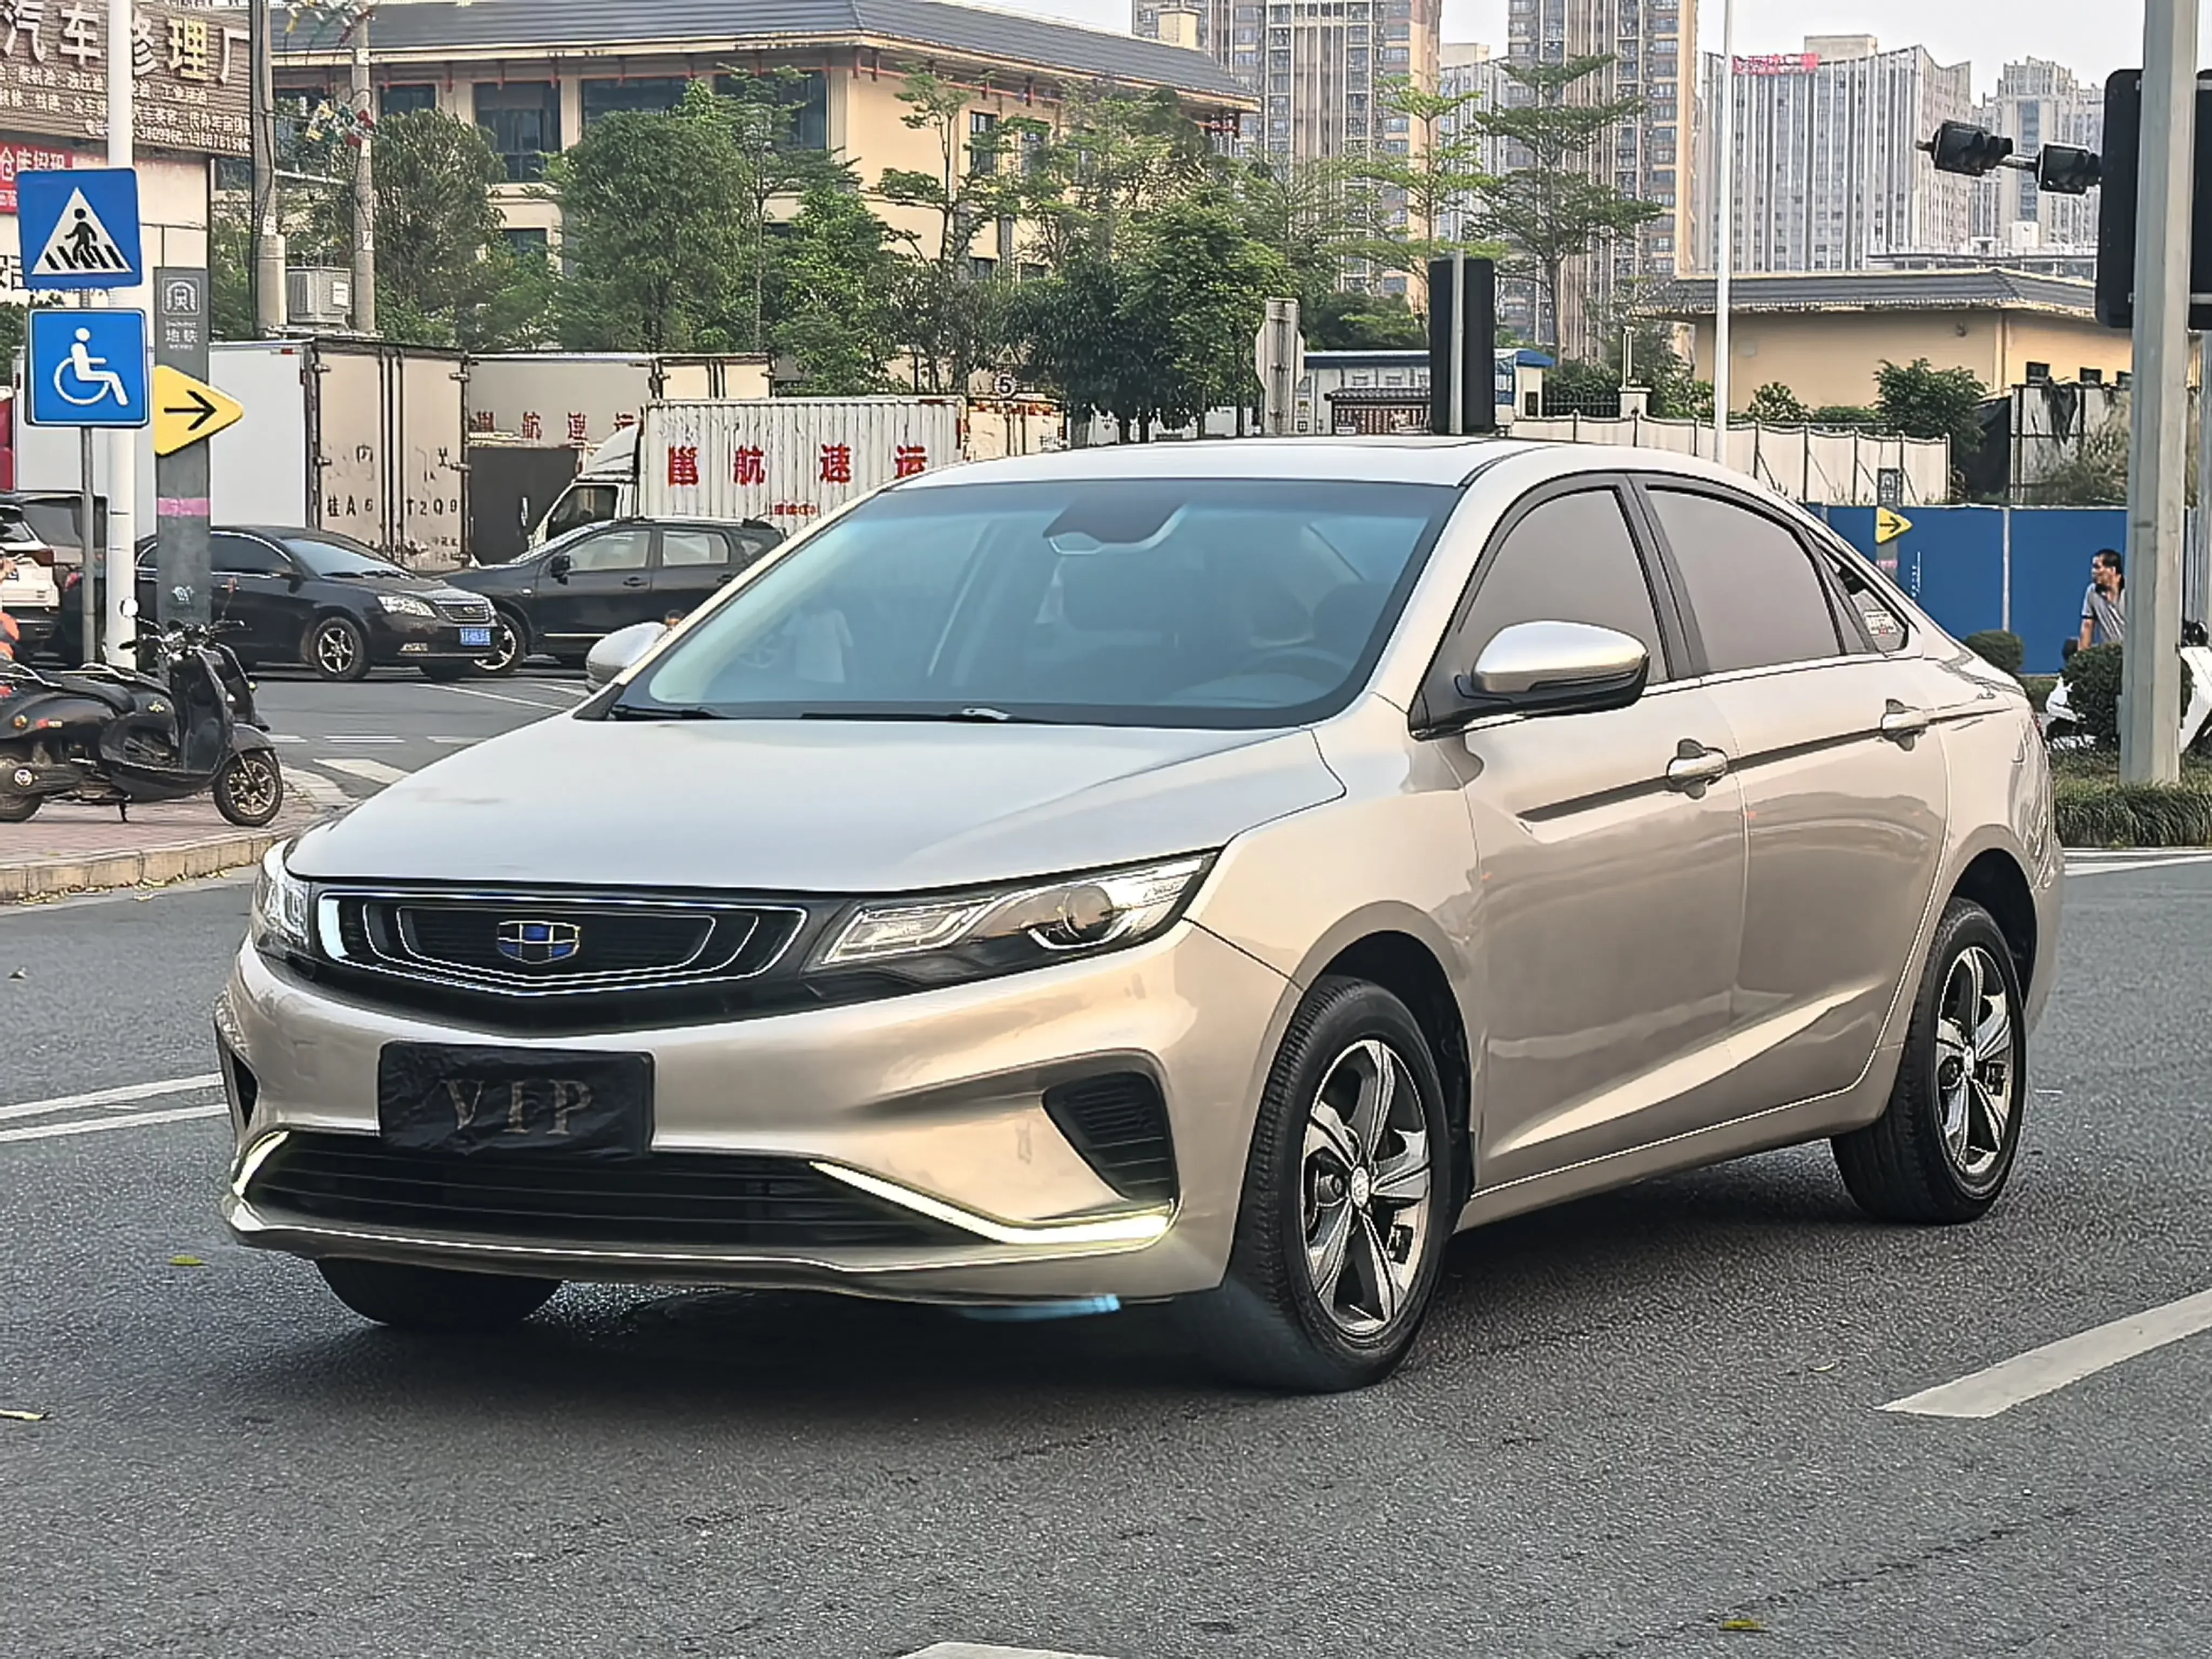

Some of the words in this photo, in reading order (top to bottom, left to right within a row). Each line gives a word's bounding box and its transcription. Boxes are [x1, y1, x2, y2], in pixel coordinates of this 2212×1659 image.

[165, 328, 198, 343] 地铁
[999, 376, 1011, 393] 5
[439, 1078, 592, 1134] VIP
